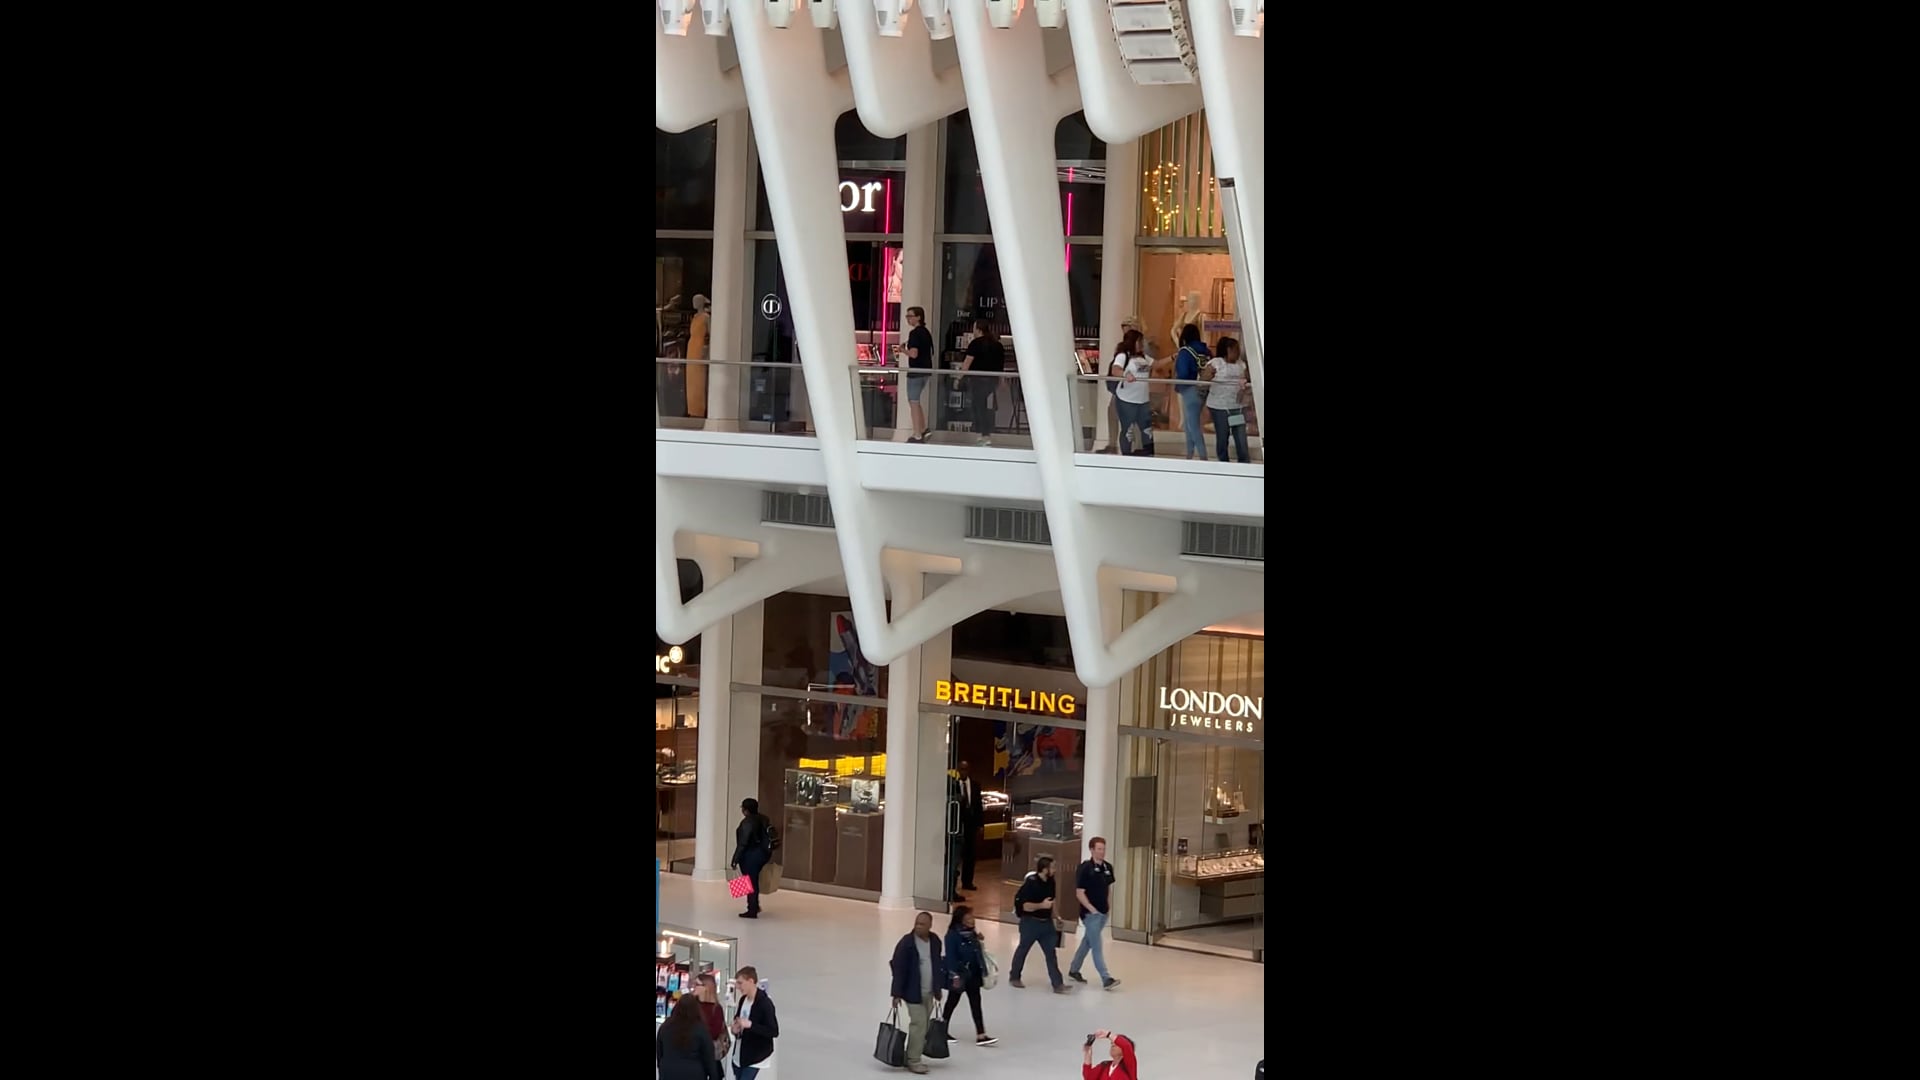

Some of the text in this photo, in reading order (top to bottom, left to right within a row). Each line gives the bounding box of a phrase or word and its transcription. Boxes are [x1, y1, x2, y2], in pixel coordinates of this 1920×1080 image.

[979, 296, 998, 308] LIP
[936, 680, 1076, 714] BREITLING
[1160, 686, 1263, 721] LONDON
[1170, 713, 1254, 733] JEWELERS
